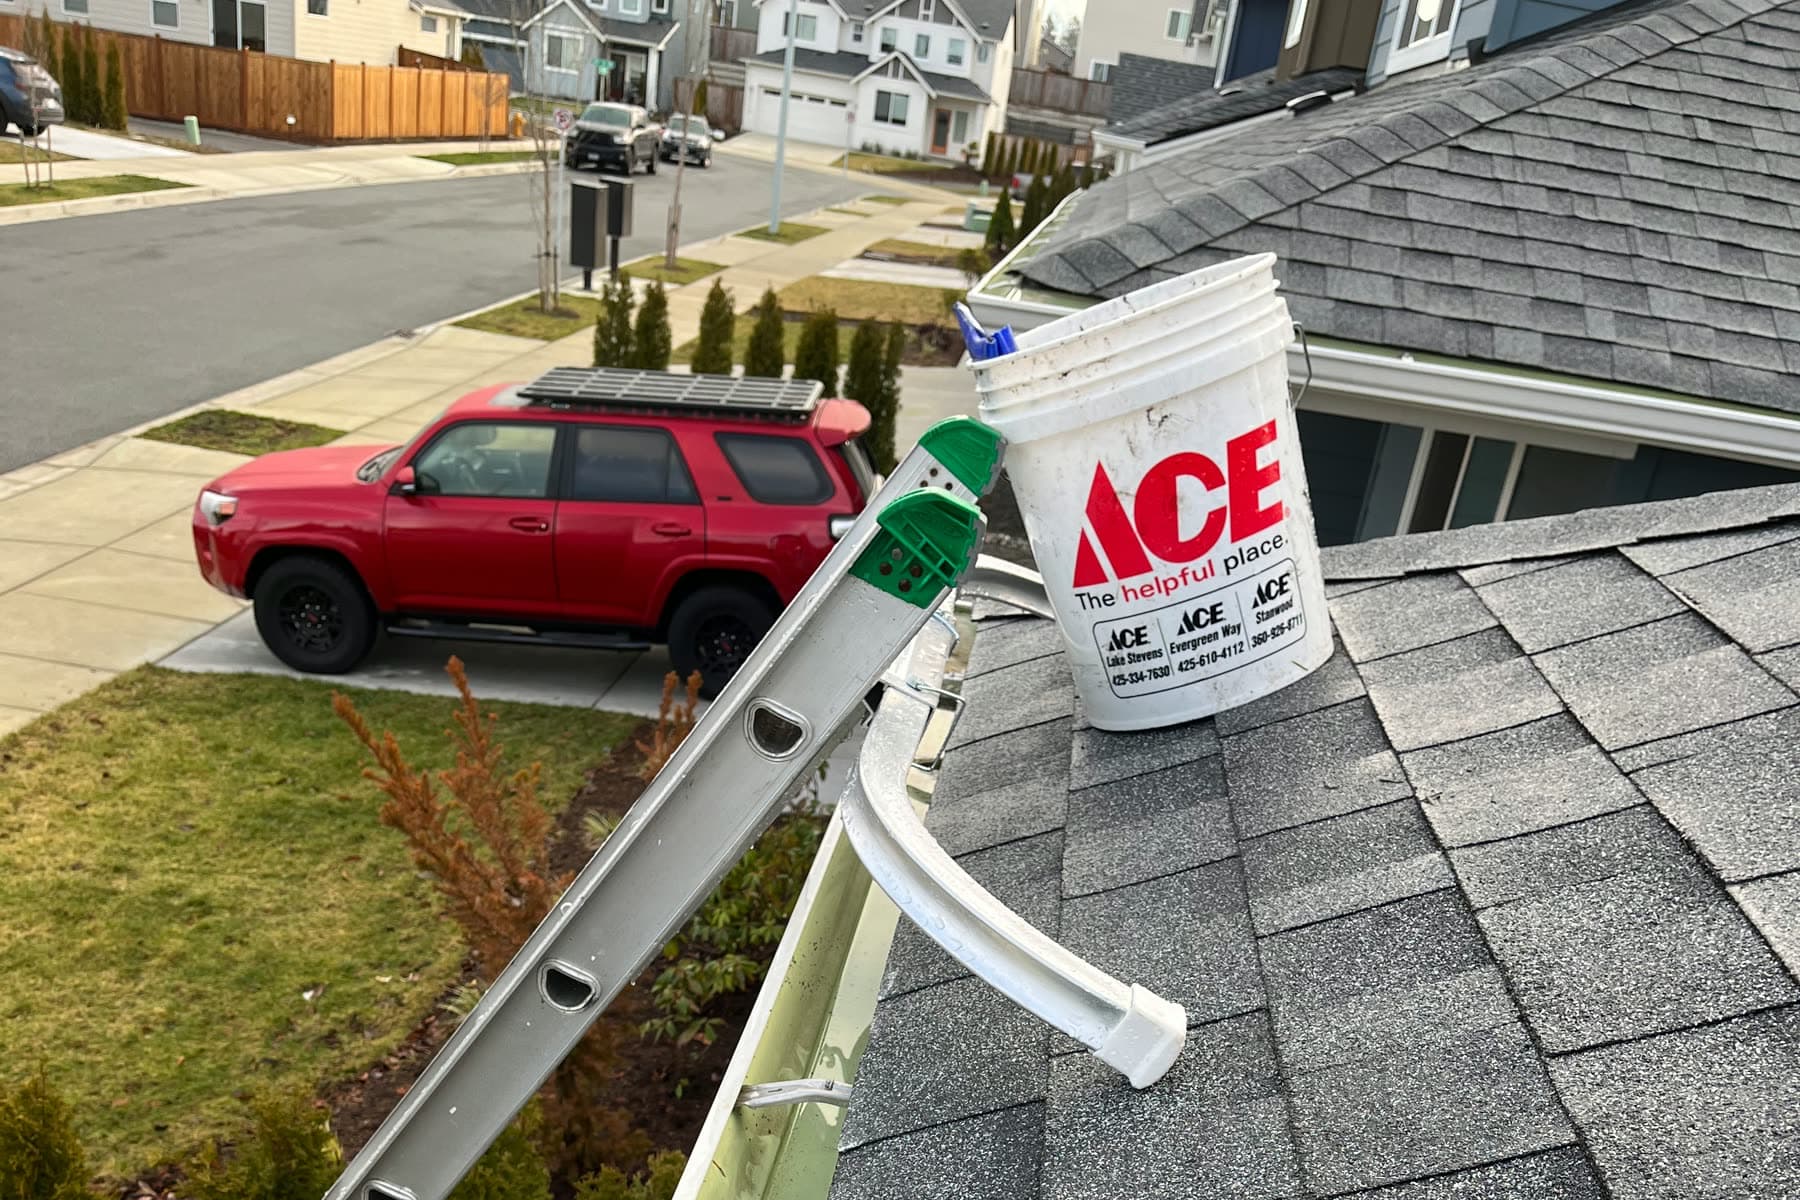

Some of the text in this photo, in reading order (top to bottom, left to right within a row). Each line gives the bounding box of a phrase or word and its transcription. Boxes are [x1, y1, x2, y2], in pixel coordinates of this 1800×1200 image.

[1073, 419, 1283, 588] ACE
[1075, 534, 1289, 611] The helpful place.
[1252, 572, 1291, 609] ACE
[1177, 602, 1224, 635] ACE
[1108, 625, 1148, 652] ACE
[1169, 622, 1241, 655] Evergreen Way
[1106, 648, 1163, 668] Lake Stevens
[1177, 641, 1244, 672] 425-610-4112
